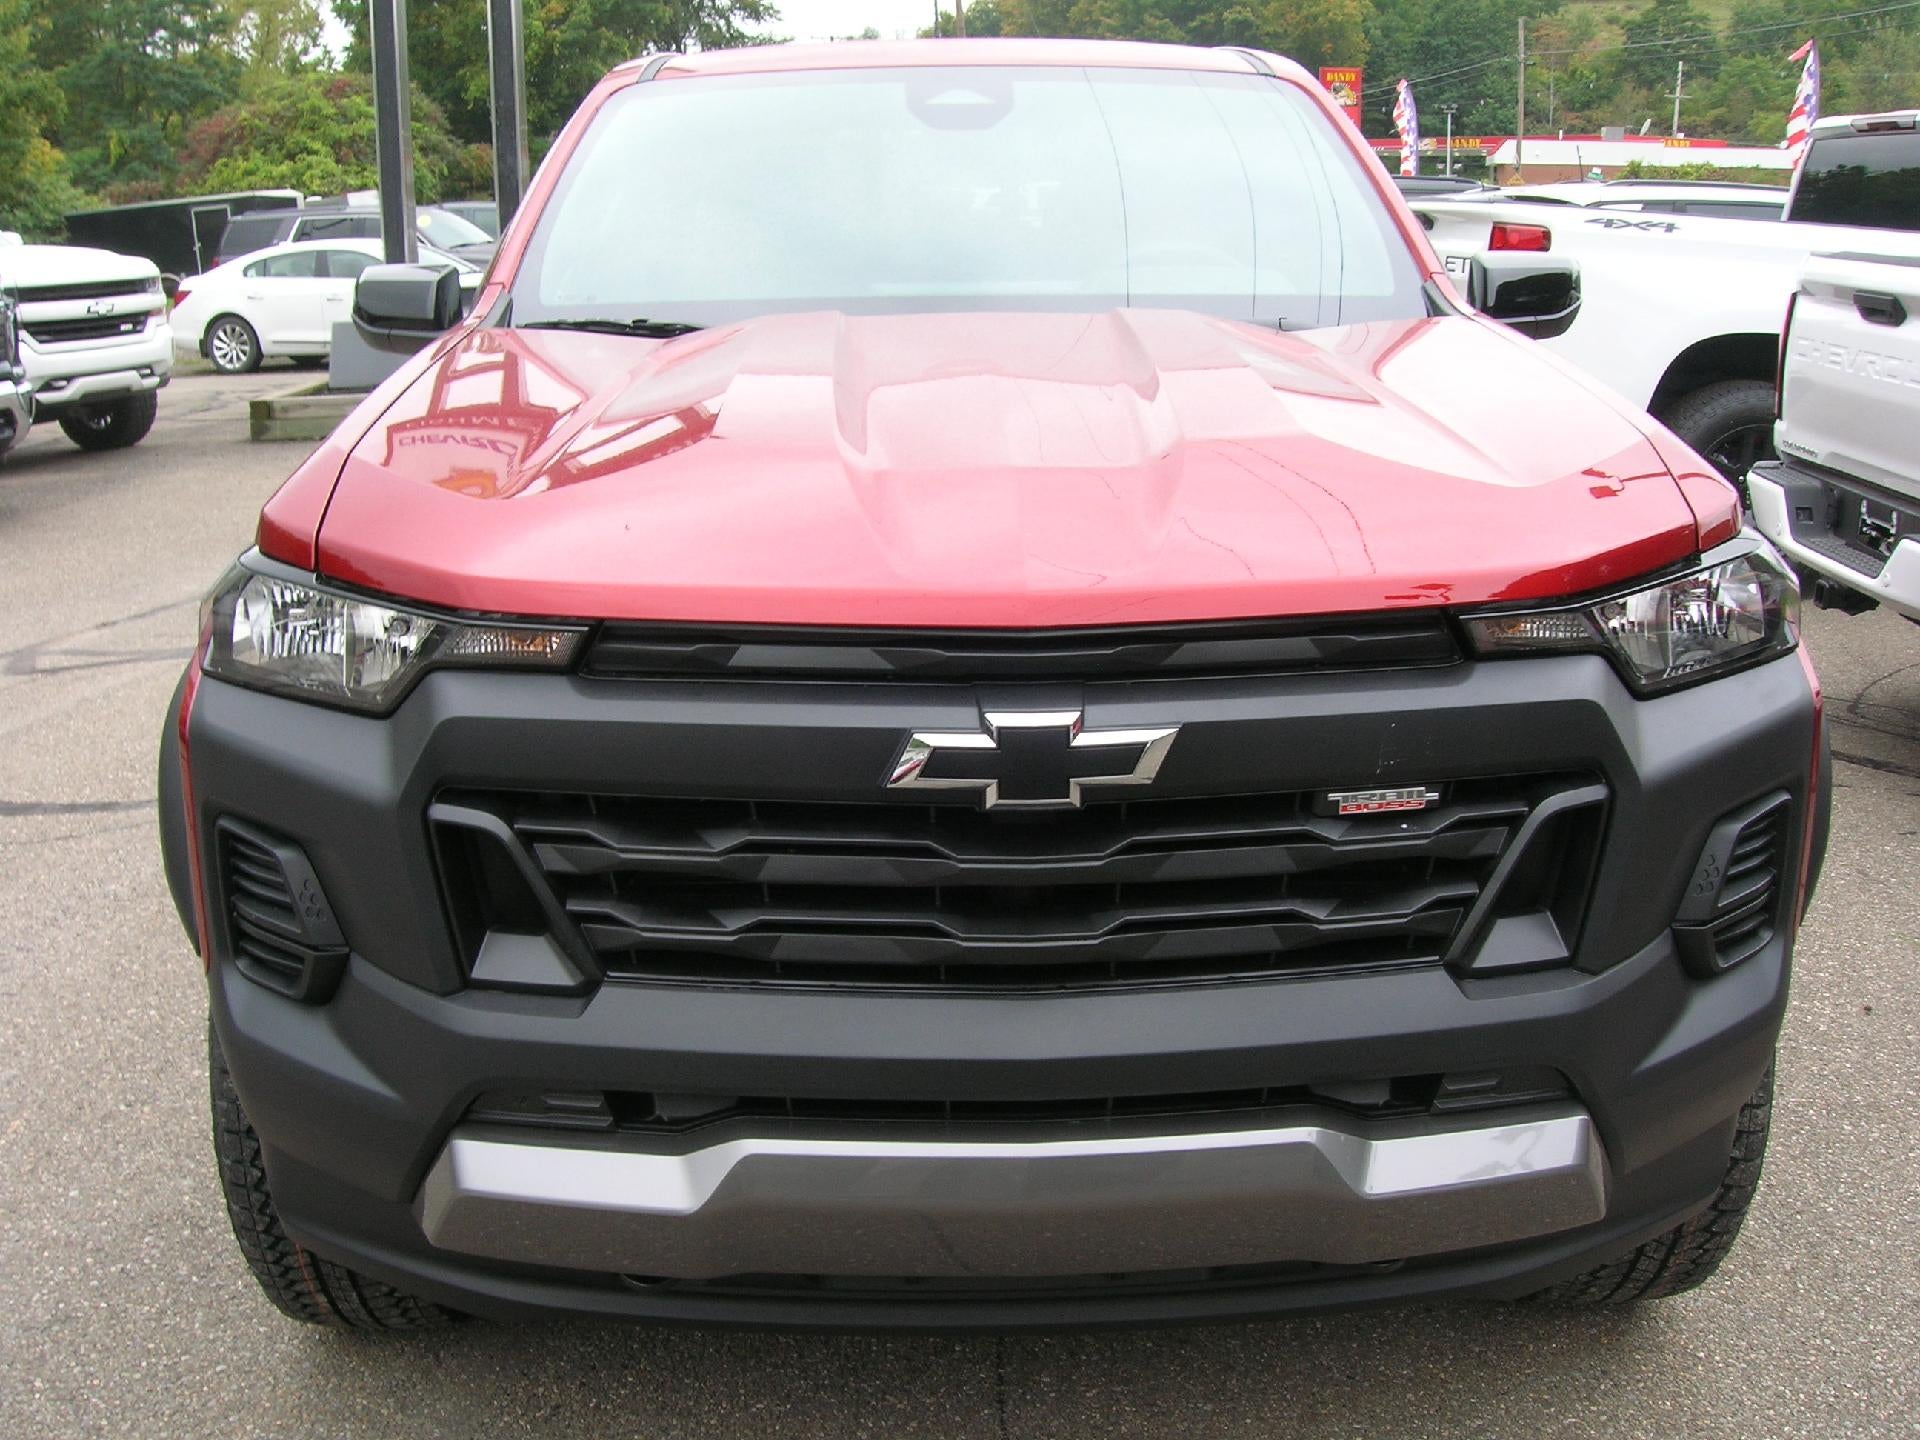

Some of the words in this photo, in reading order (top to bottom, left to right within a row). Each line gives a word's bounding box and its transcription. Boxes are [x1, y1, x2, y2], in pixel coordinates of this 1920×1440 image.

[1326, 72, 1357, 81] DANDY
[1328, 787, 1439, 801] TRAIL
[1339, 800, 1425, 814] BOSS
